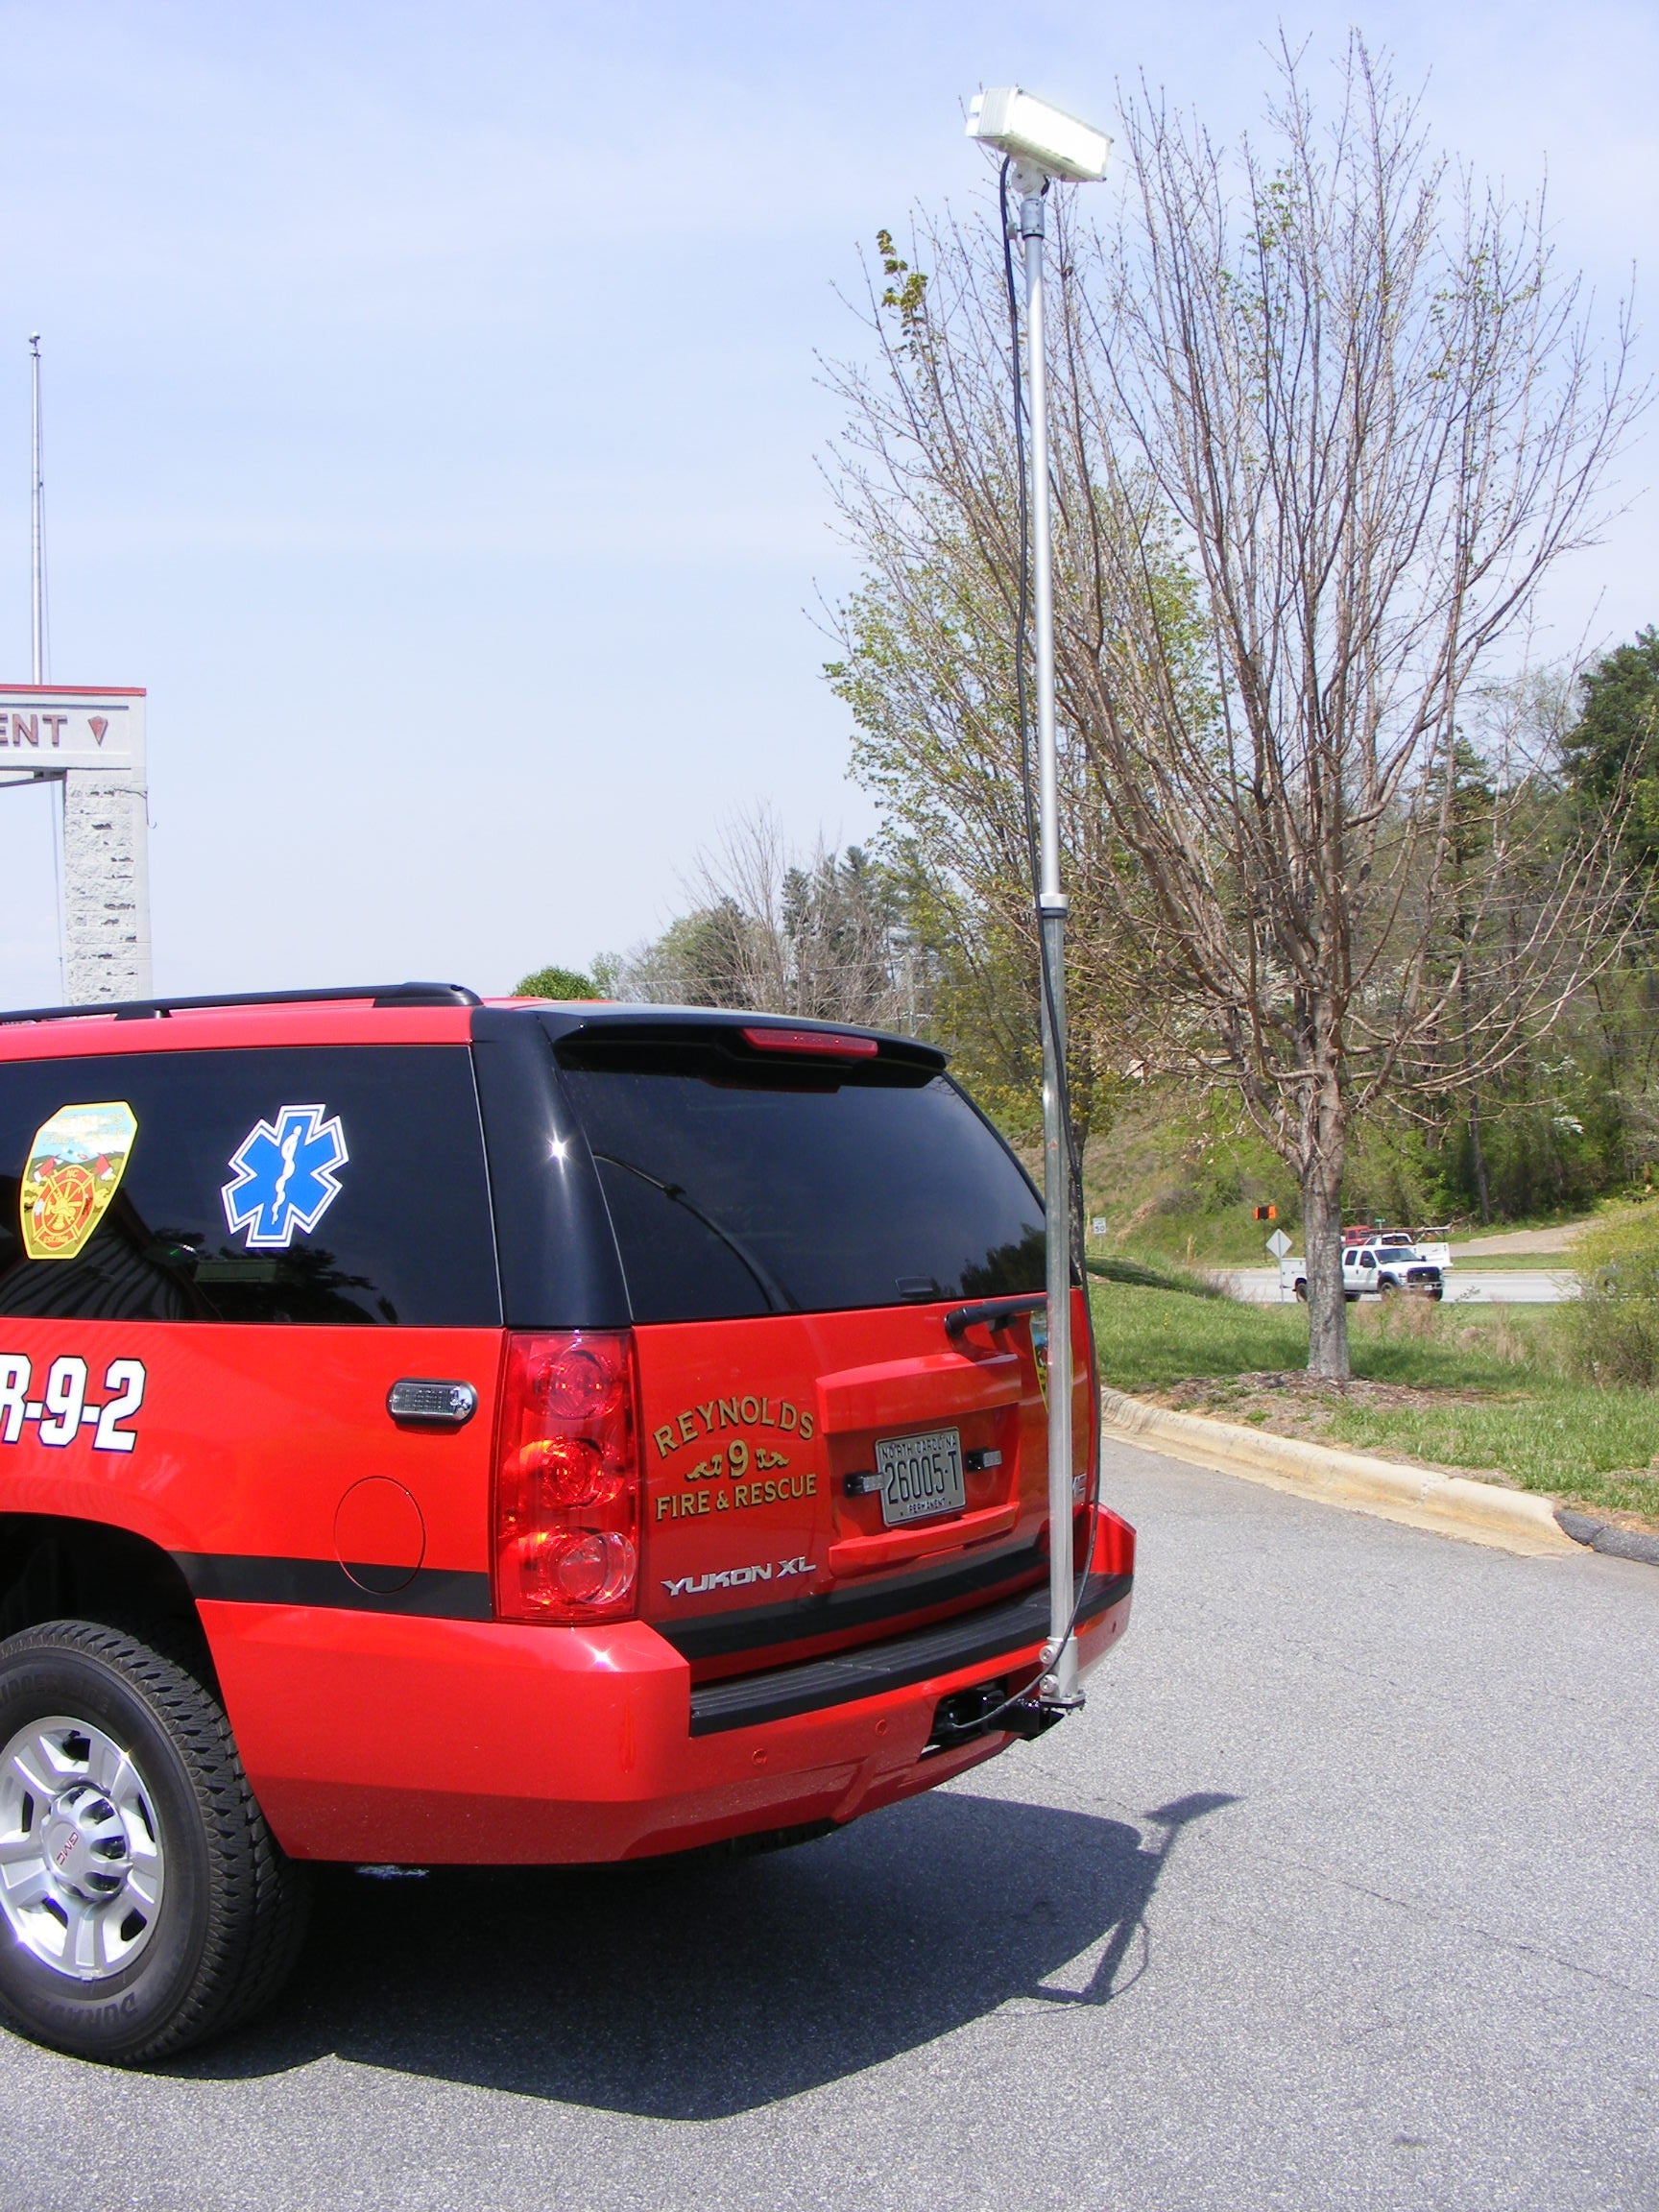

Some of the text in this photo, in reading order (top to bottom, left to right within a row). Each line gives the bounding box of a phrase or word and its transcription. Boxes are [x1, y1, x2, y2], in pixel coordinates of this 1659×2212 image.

[66, 1168, 79, 1178] NC
[0, 1354, 147, 1453] R-9-2
[654, 1395, 814, 1459] REYNOLDS
[728, 1439, 750, 1477] 9
[880, 1435, 957, 1459] NORTH CAROLINA
[656, 1474, 817, 1520] FIRE & RESCUE
[907, 1498, 945, 1513] PERMANENT
[661, 1555, 816, 1597] YUKON XL
[57, 1832, 79, 1865] GMC
